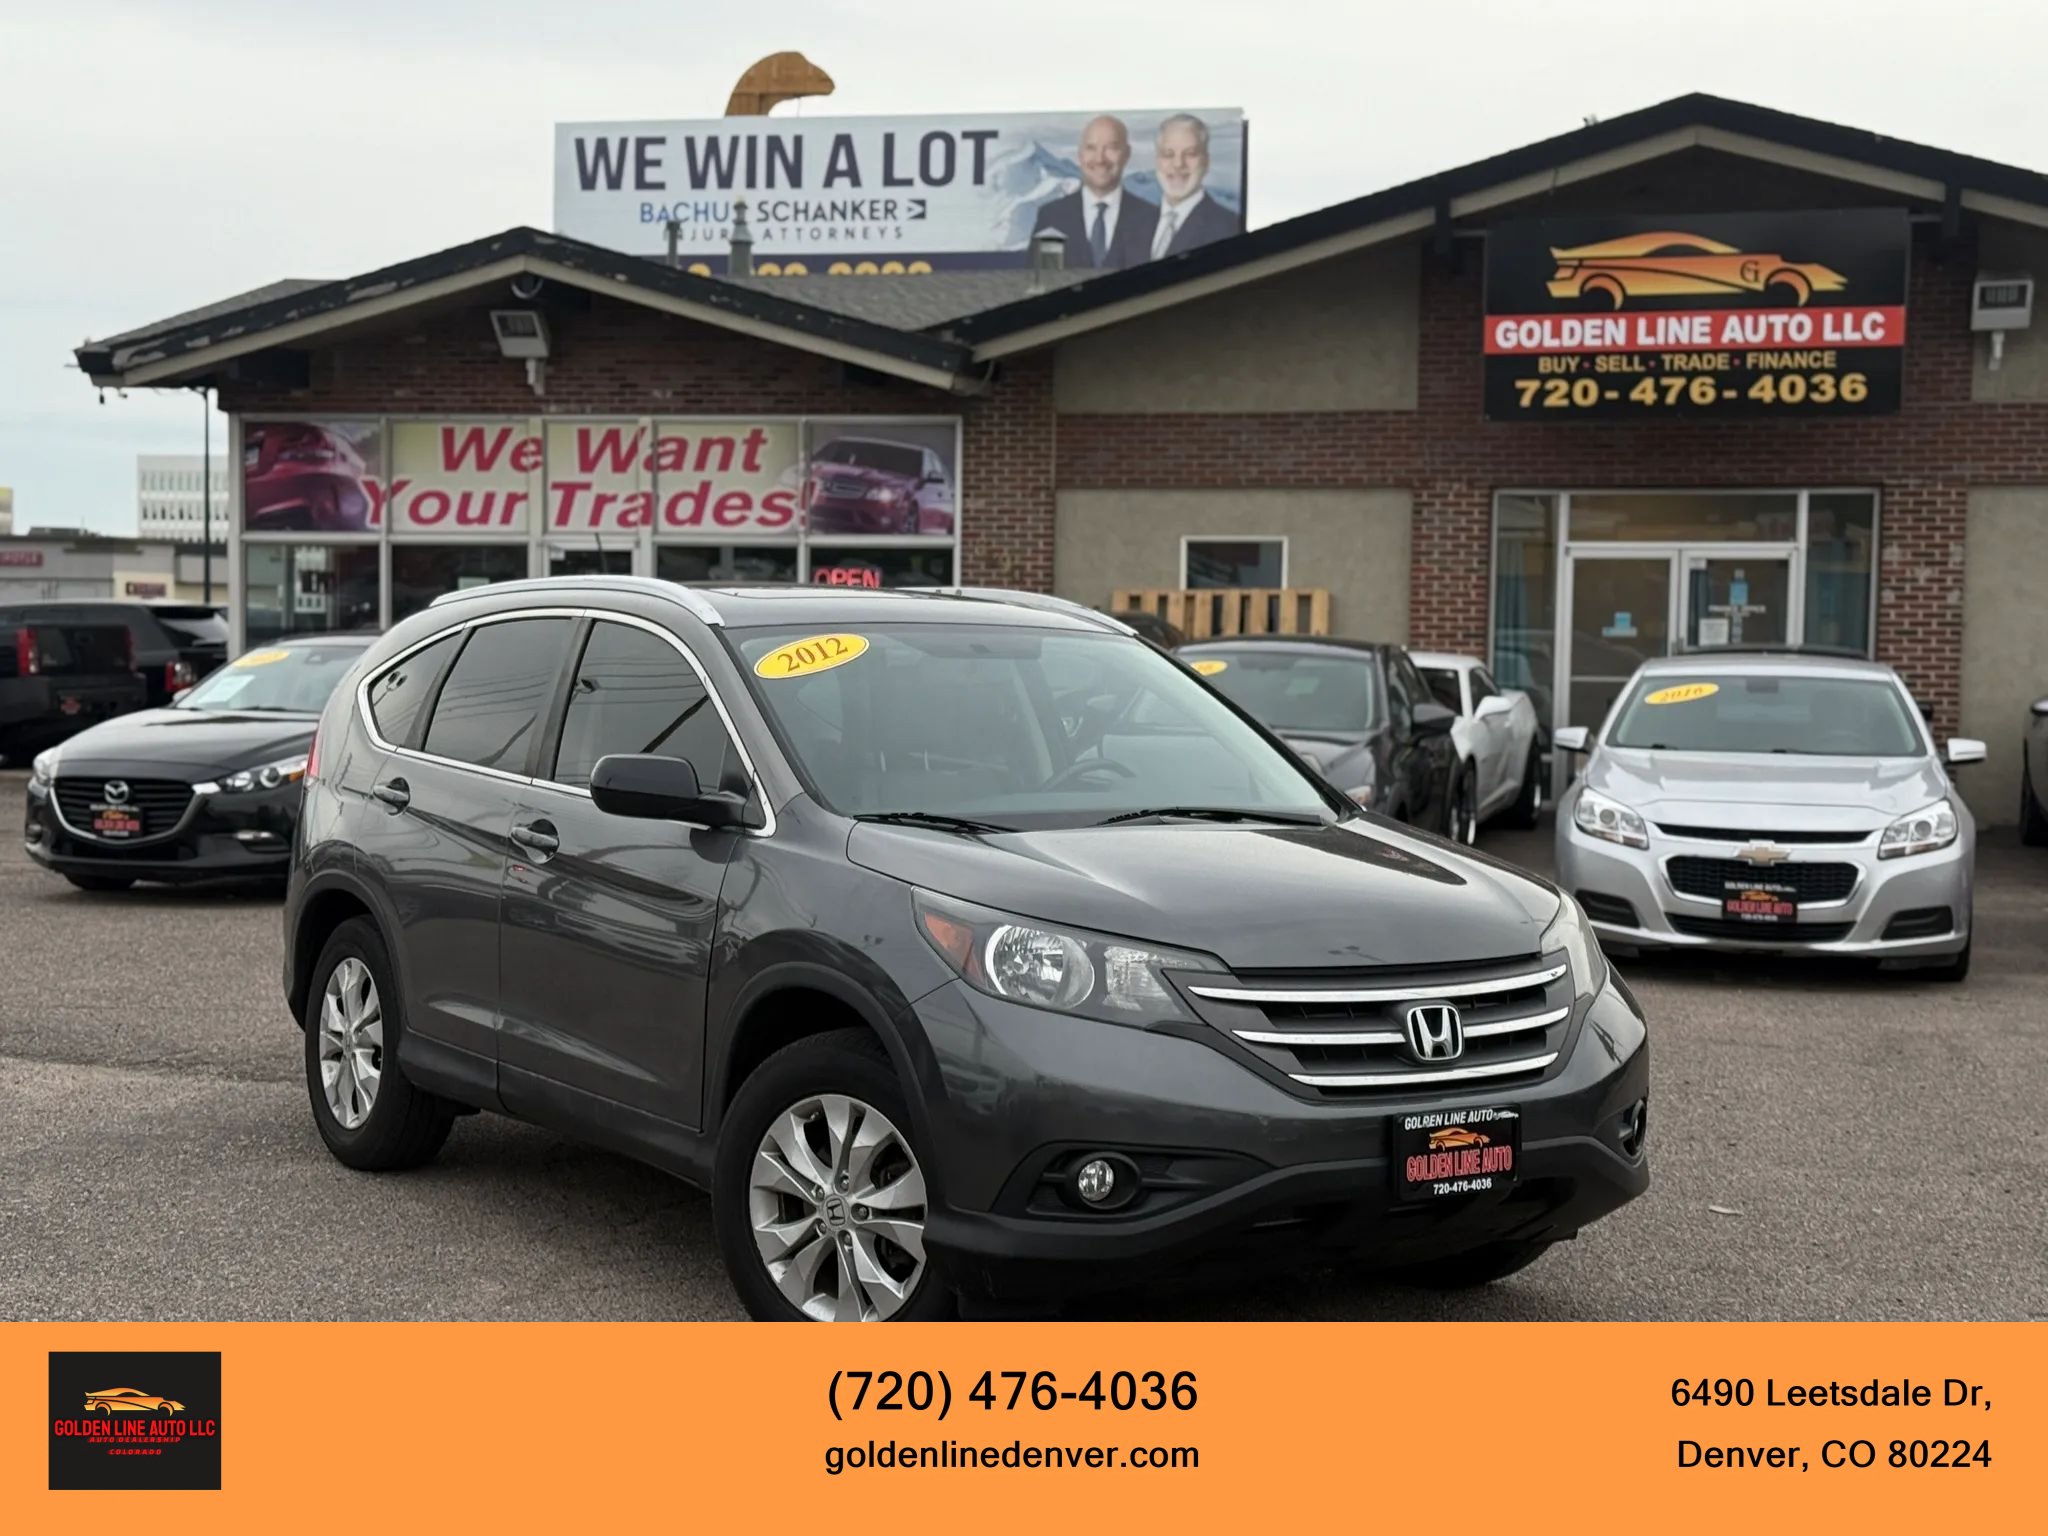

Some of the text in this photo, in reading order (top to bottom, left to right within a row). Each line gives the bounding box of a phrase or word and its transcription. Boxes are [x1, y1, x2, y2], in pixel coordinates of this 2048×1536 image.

[574, 129, 999, 191] WE WIN A LOT
[640, 199, 899, 224] BACHU SCHANKER
[762, 226, 903, 241] ATTORNEYS
[1494, 311, 1886, 350] GOLDEN LINE AUTO LLC
[1538, 350, 1837, 374] BUY SELL TRADE FINANCE
[1514, 373, 1869, 408] 720-476-4036
[441, 425, 768, 474] We Want
[361, 479, 529, 526] Your
[814, 567, 881, 589] OPEN
[776, 637, 849, 673] 2012
[1444, 1111, 1467, 1126] LINE
[1467, 1108, 1493, 1124] AUTO
[1406, 1145, 1513, 1183] GOLDEN LINE AUTO
[1433, 1177, 1492, 1195] 720-476-4036
